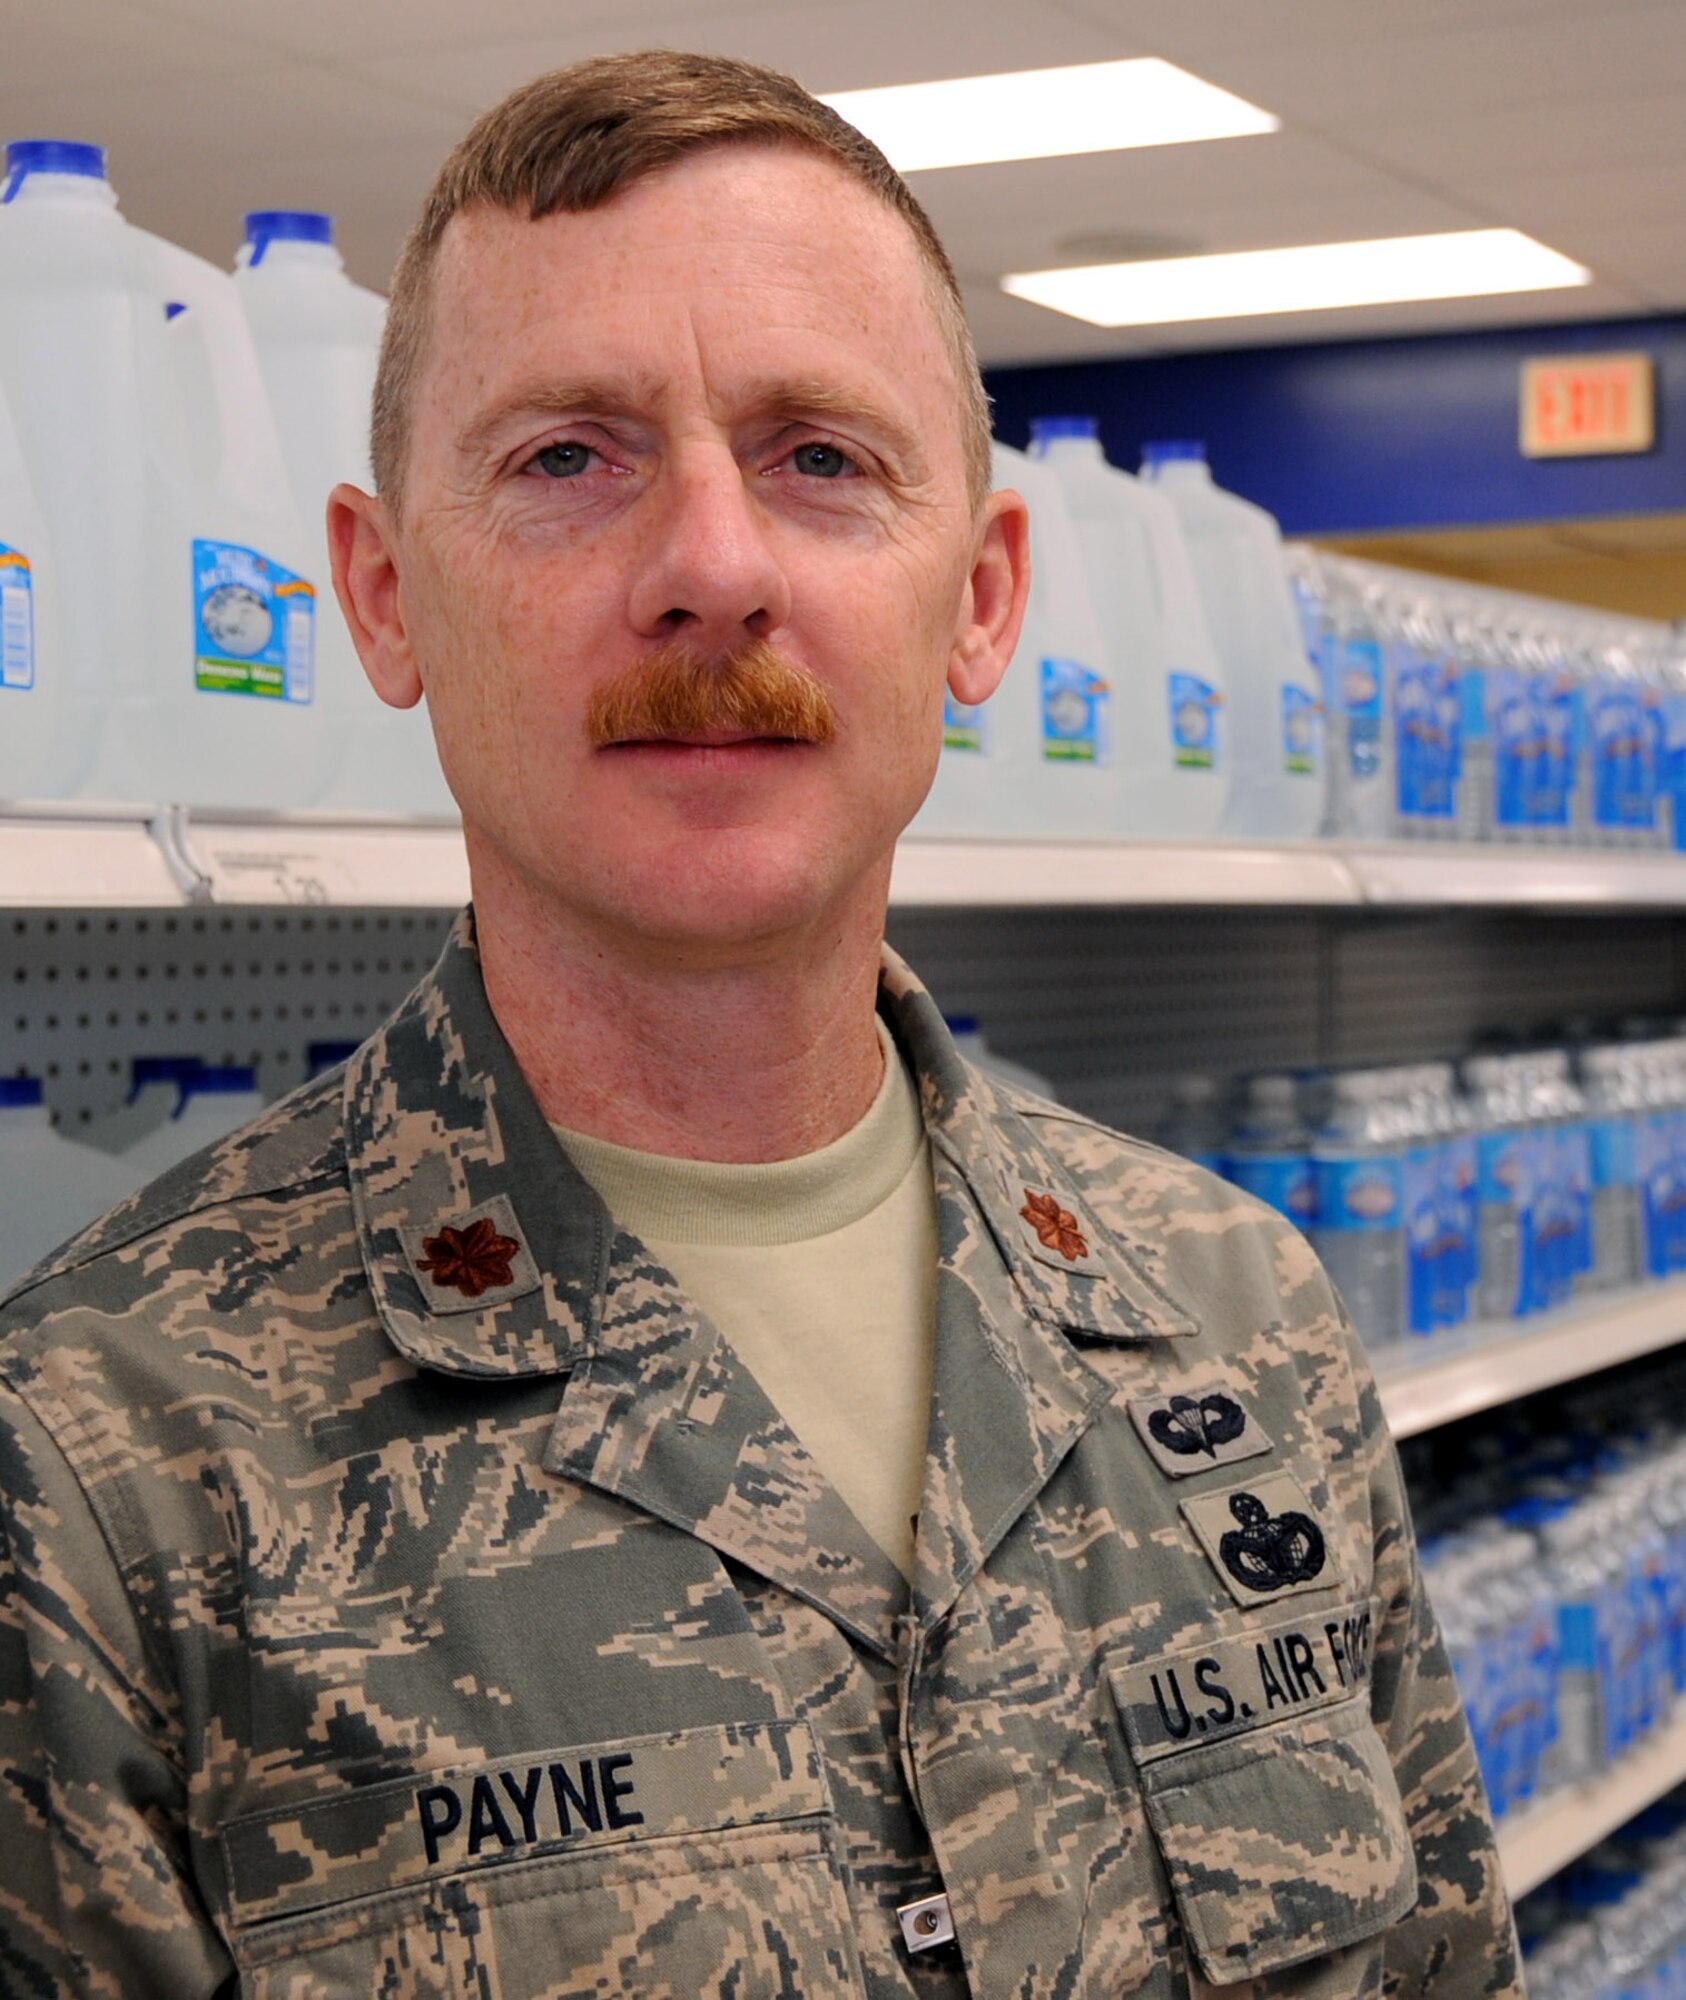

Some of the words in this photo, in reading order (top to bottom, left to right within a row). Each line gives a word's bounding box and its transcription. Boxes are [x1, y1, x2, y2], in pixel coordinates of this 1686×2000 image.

[1535, 367, 1634, 444] EXIT
[1150, 1657, 1254, 1739] U.S.
[1256, 1633, 1327, 1709] AIR
[416, 1752, 644, 1865] PAYNE
